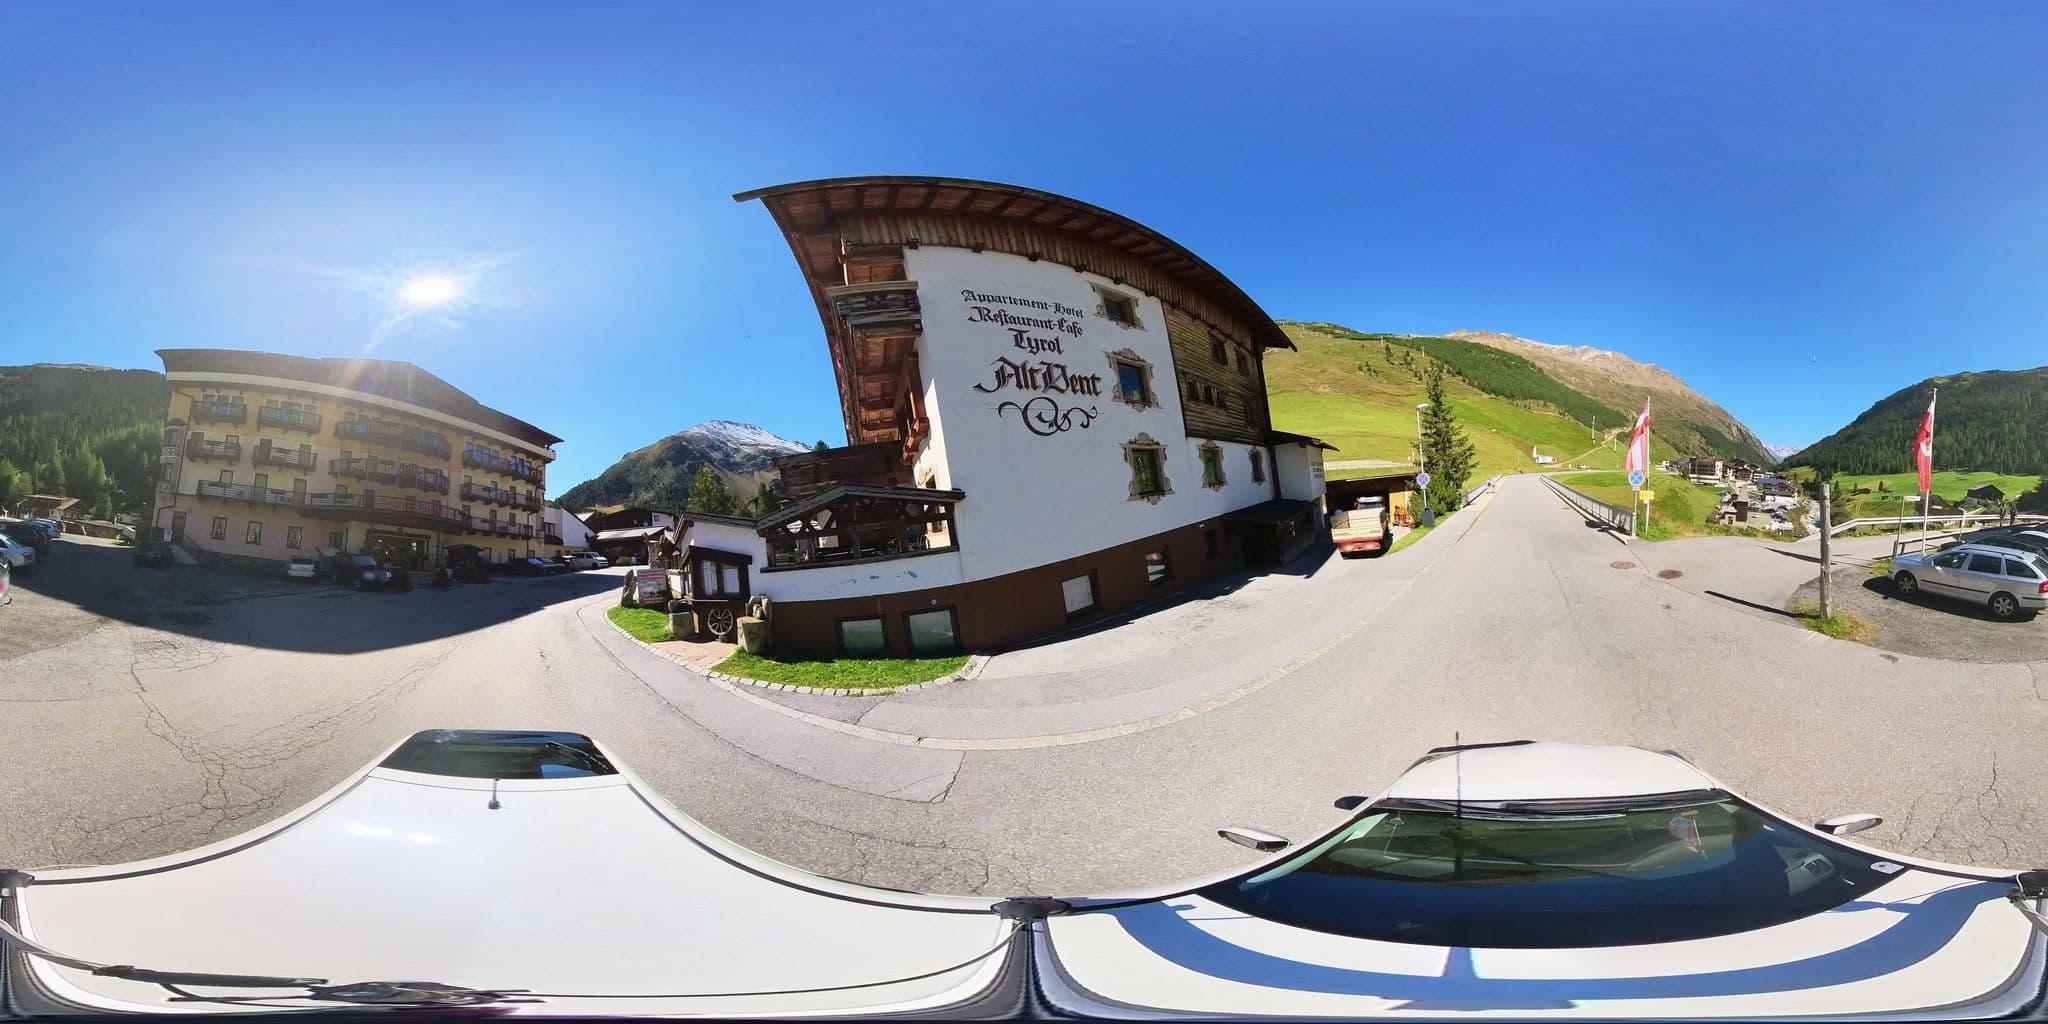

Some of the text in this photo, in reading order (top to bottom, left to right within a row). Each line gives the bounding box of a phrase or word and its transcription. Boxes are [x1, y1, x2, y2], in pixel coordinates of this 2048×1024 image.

[961, 289, 1084, 318] Appartement-Hotel
[1007, 327, 1064, 355] Tyrol
[972, 356, 1041, 393] Alt
